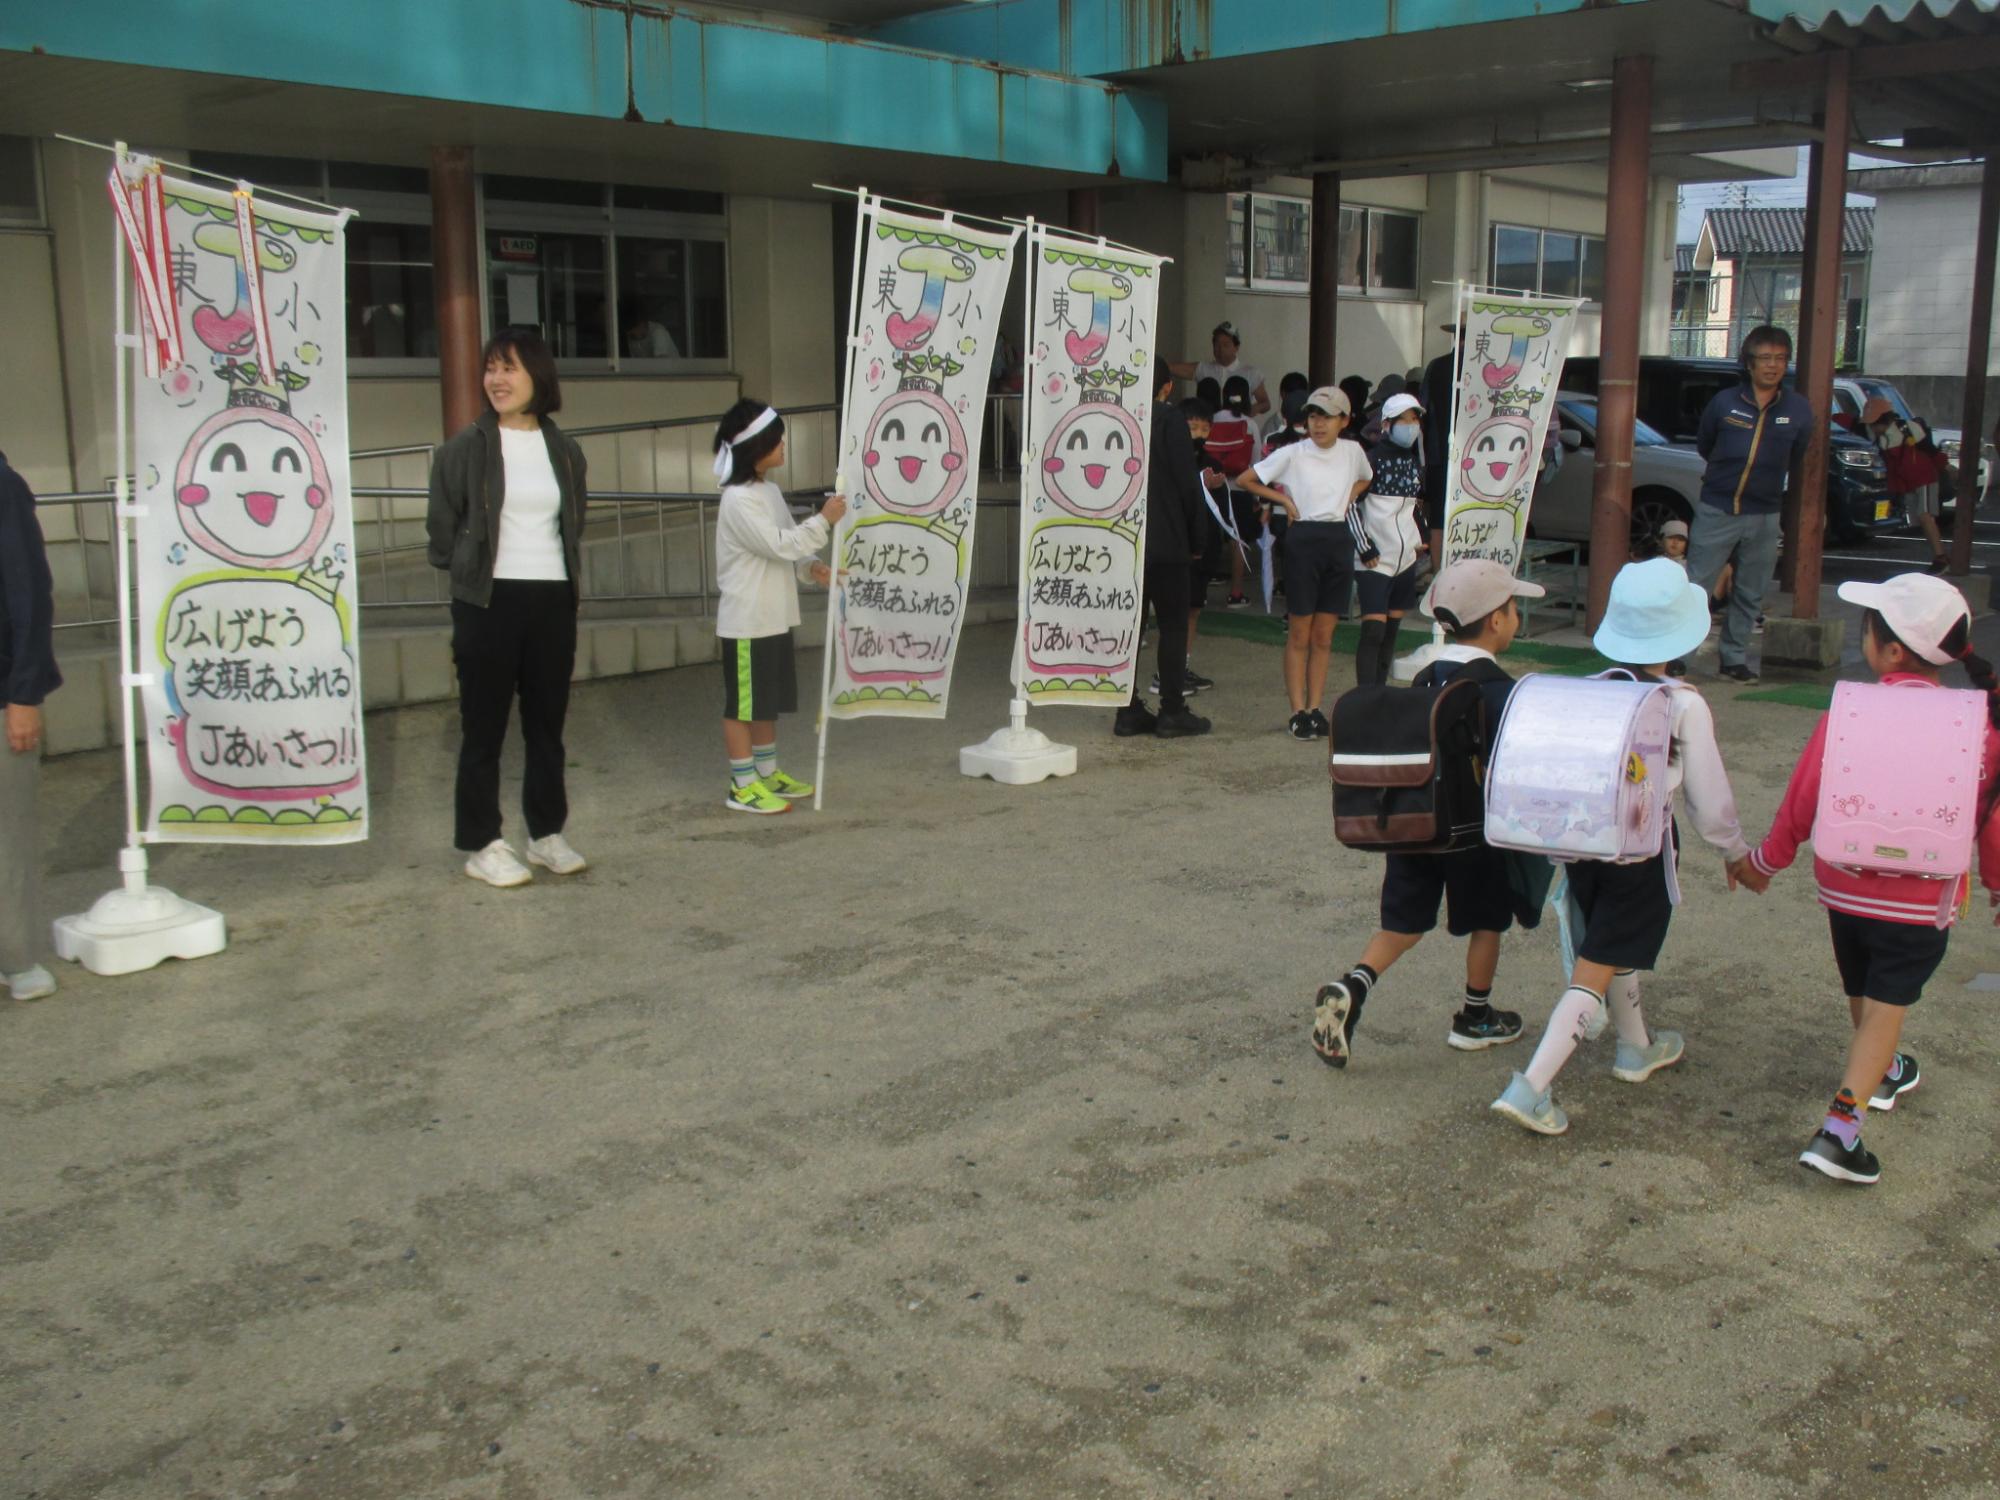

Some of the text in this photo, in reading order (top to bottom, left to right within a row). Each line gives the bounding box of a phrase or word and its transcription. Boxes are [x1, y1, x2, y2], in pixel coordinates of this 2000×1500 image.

[512, 239, 535, 250] AED
[845, 534, 929, 576] 広げよう
[1029, 536, 1112, 574] 広げよう
[848, 576, 955, 616] 笑顔あふれる
[1032, 576, 1135, 611] 笑顔あふれる
[168, 600, 304, 653] 広げよう
[187, 657, 350, 702] 笑顔あふれる
